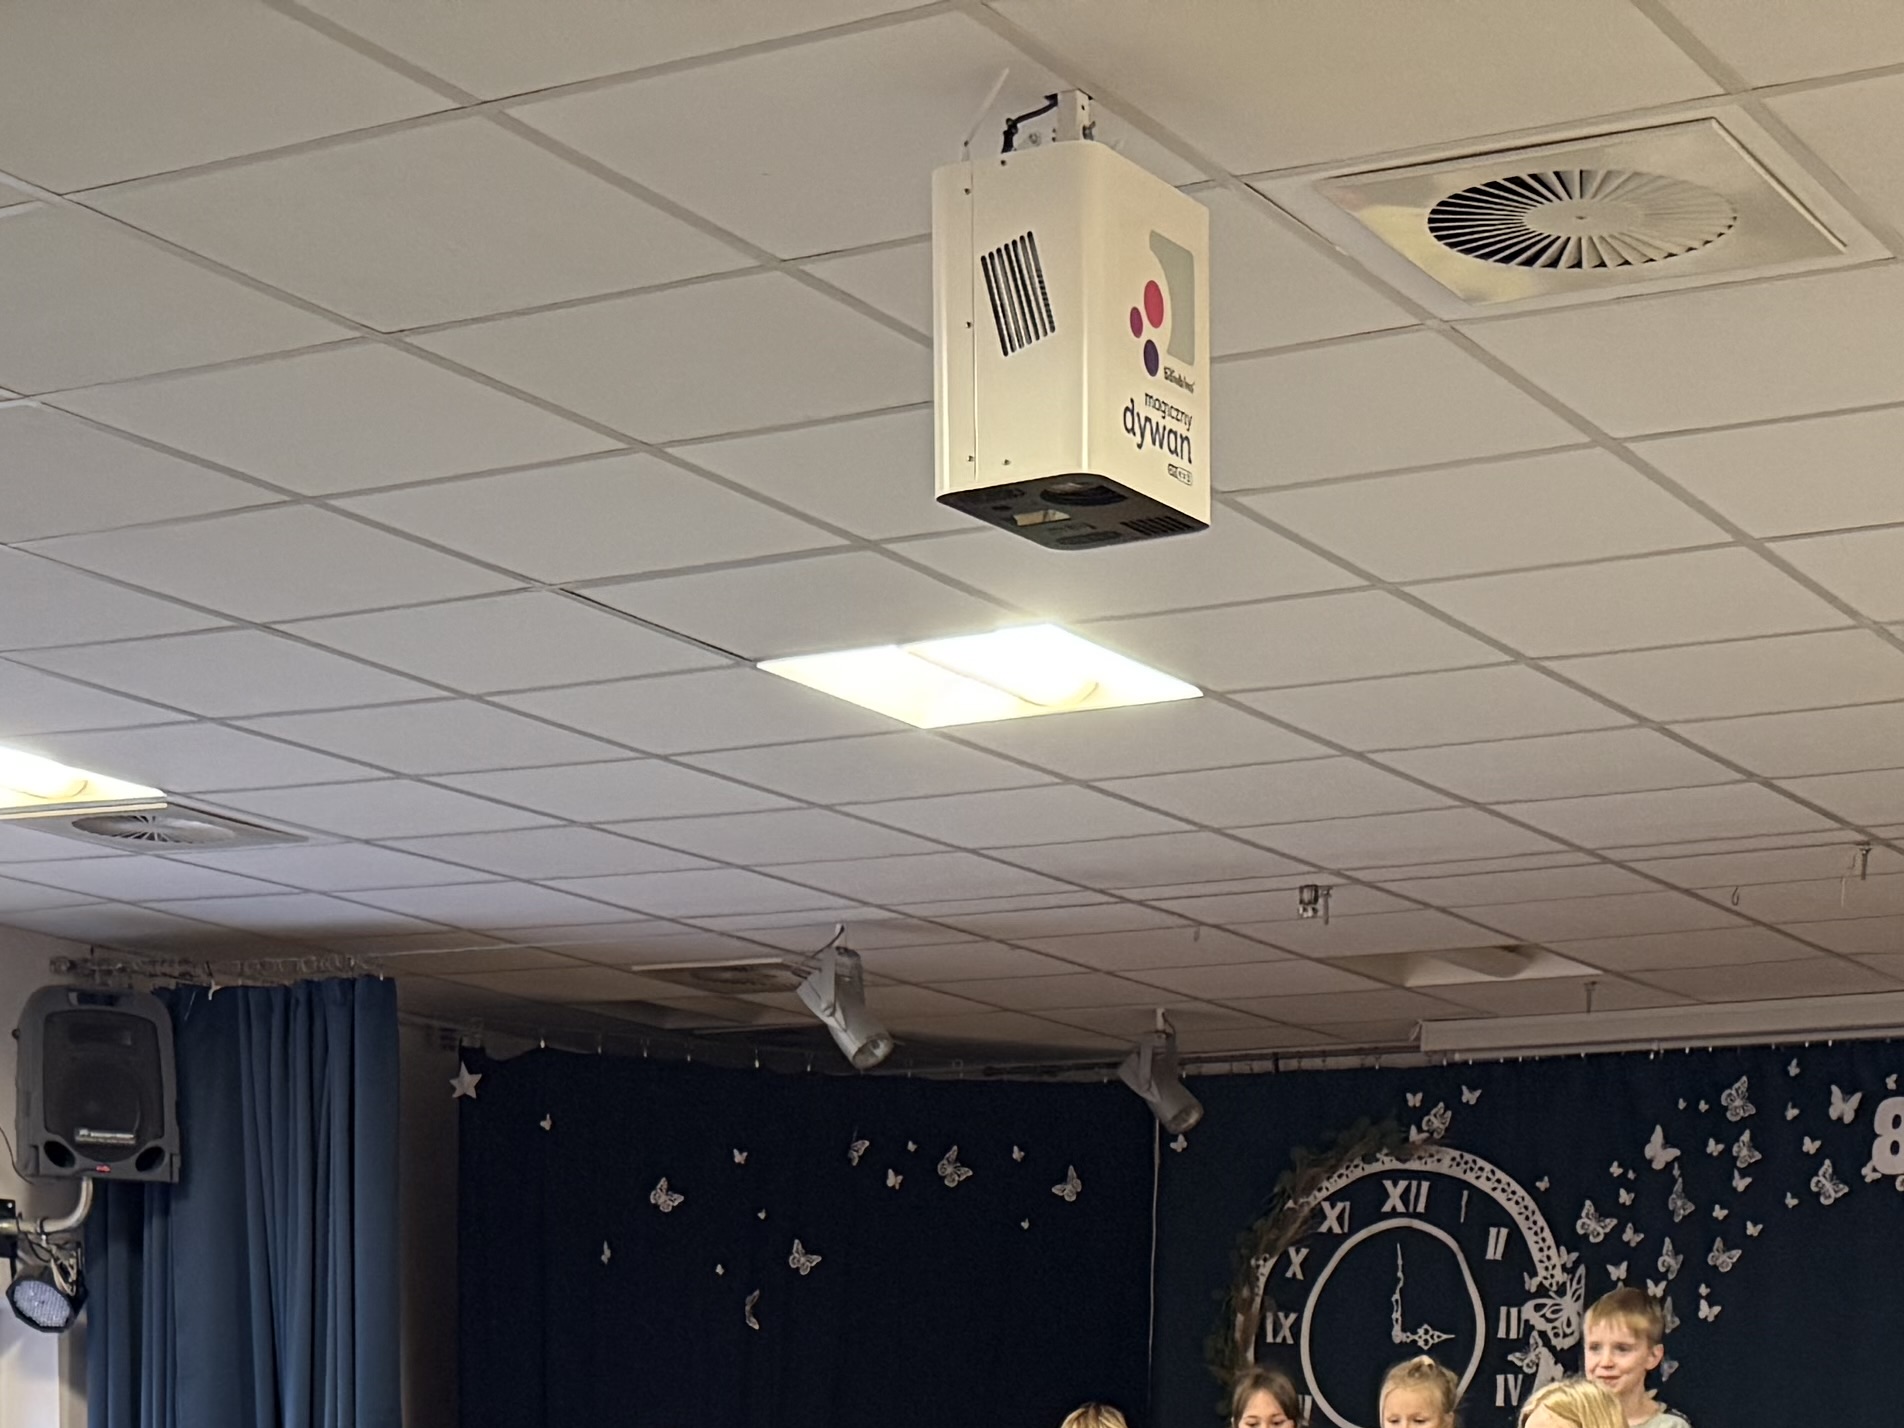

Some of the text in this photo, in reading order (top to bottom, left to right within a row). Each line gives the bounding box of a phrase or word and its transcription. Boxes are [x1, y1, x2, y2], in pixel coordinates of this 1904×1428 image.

[1123, 397, 1193, 464] dywan
[1381, 1180, 1430, 1213] XII
[1318, 1201, 1350, 1233] XI
[1486, 1227, 1509, 1260] II
[1285, 1247, 1309, 1280] X
[1266, 1312, 1298, 1344] IX
[1495, 1374, 1522, 1407] IV
